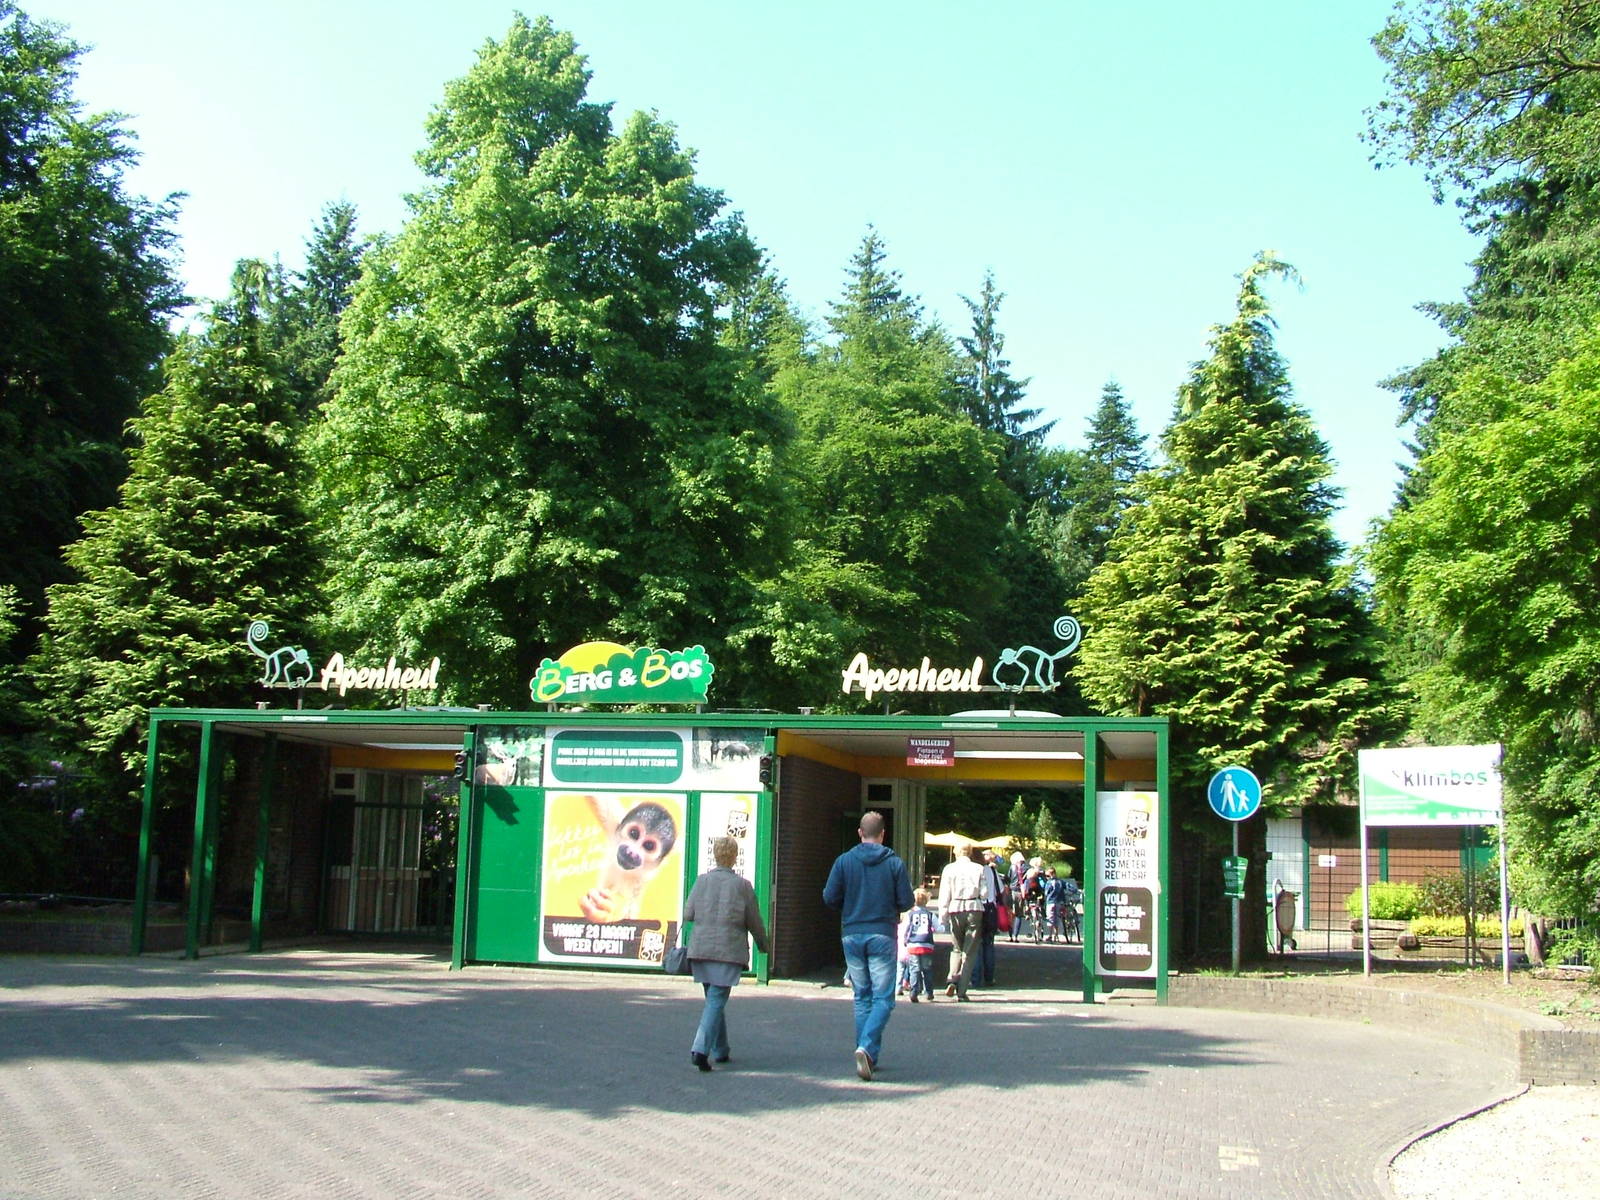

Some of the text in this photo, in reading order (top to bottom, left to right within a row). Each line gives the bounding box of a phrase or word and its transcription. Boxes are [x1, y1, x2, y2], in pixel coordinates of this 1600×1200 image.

[320, 652, 441, 697] Apenheul
[538, 655, 703, 700] BERG & BOS
[841, 652, 984, 701] Apenheul
[1403, 769, 1488, 787] klimbos
[1104, 836, 1136, 847] NIEUWE
[1104, 847, 1146, 858] ROUTE NA
[1104, 858, 1146, 869] 35 METER
[1104, 869, 1147, 880] RECHTSAF
[1104, 905, 1116, 917] DE
[563, 937, 592, 953] WEER
